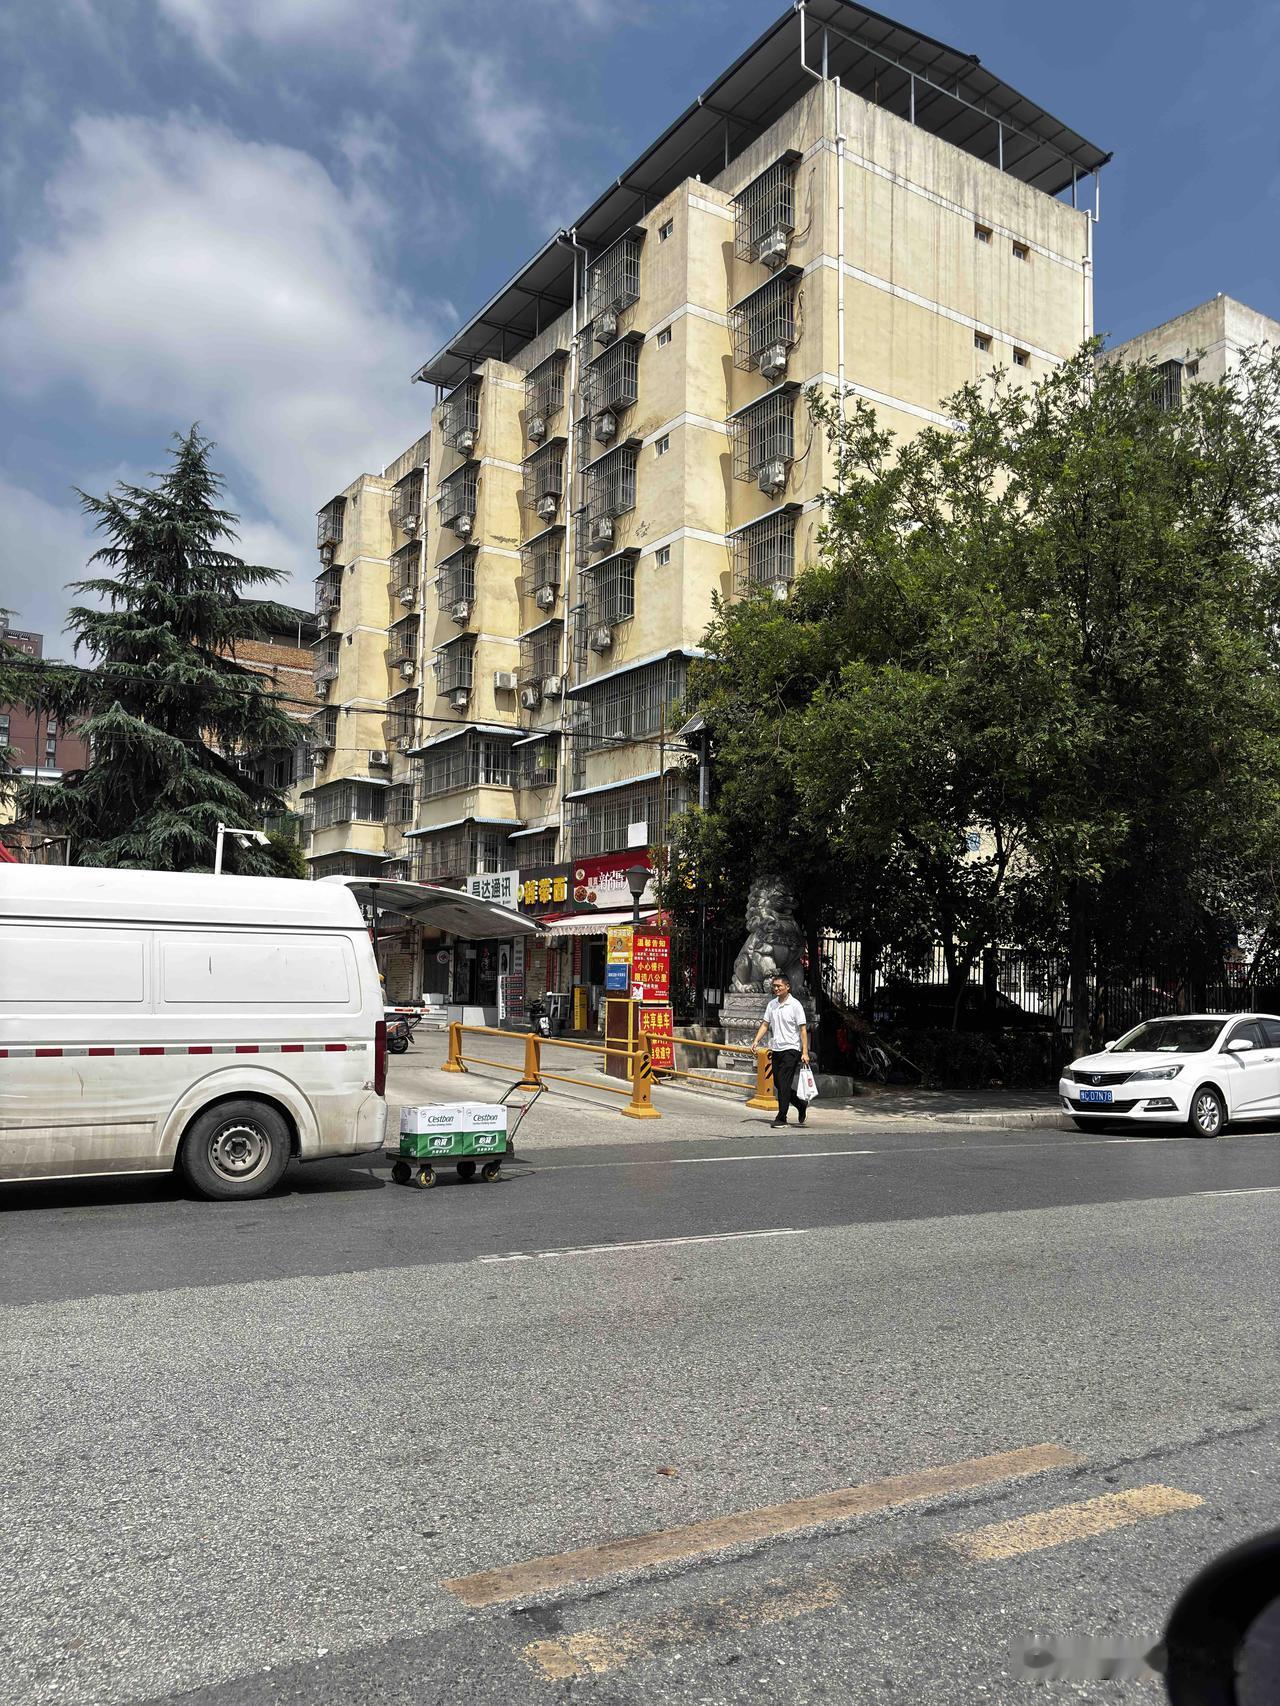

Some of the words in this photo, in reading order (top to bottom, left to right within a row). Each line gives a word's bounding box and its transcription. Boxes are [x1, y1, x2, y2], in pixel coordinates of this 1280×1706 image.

[472, 877, 511, 899] 昌达通讯
[643, 1012, 670, 1030] 共享单车
